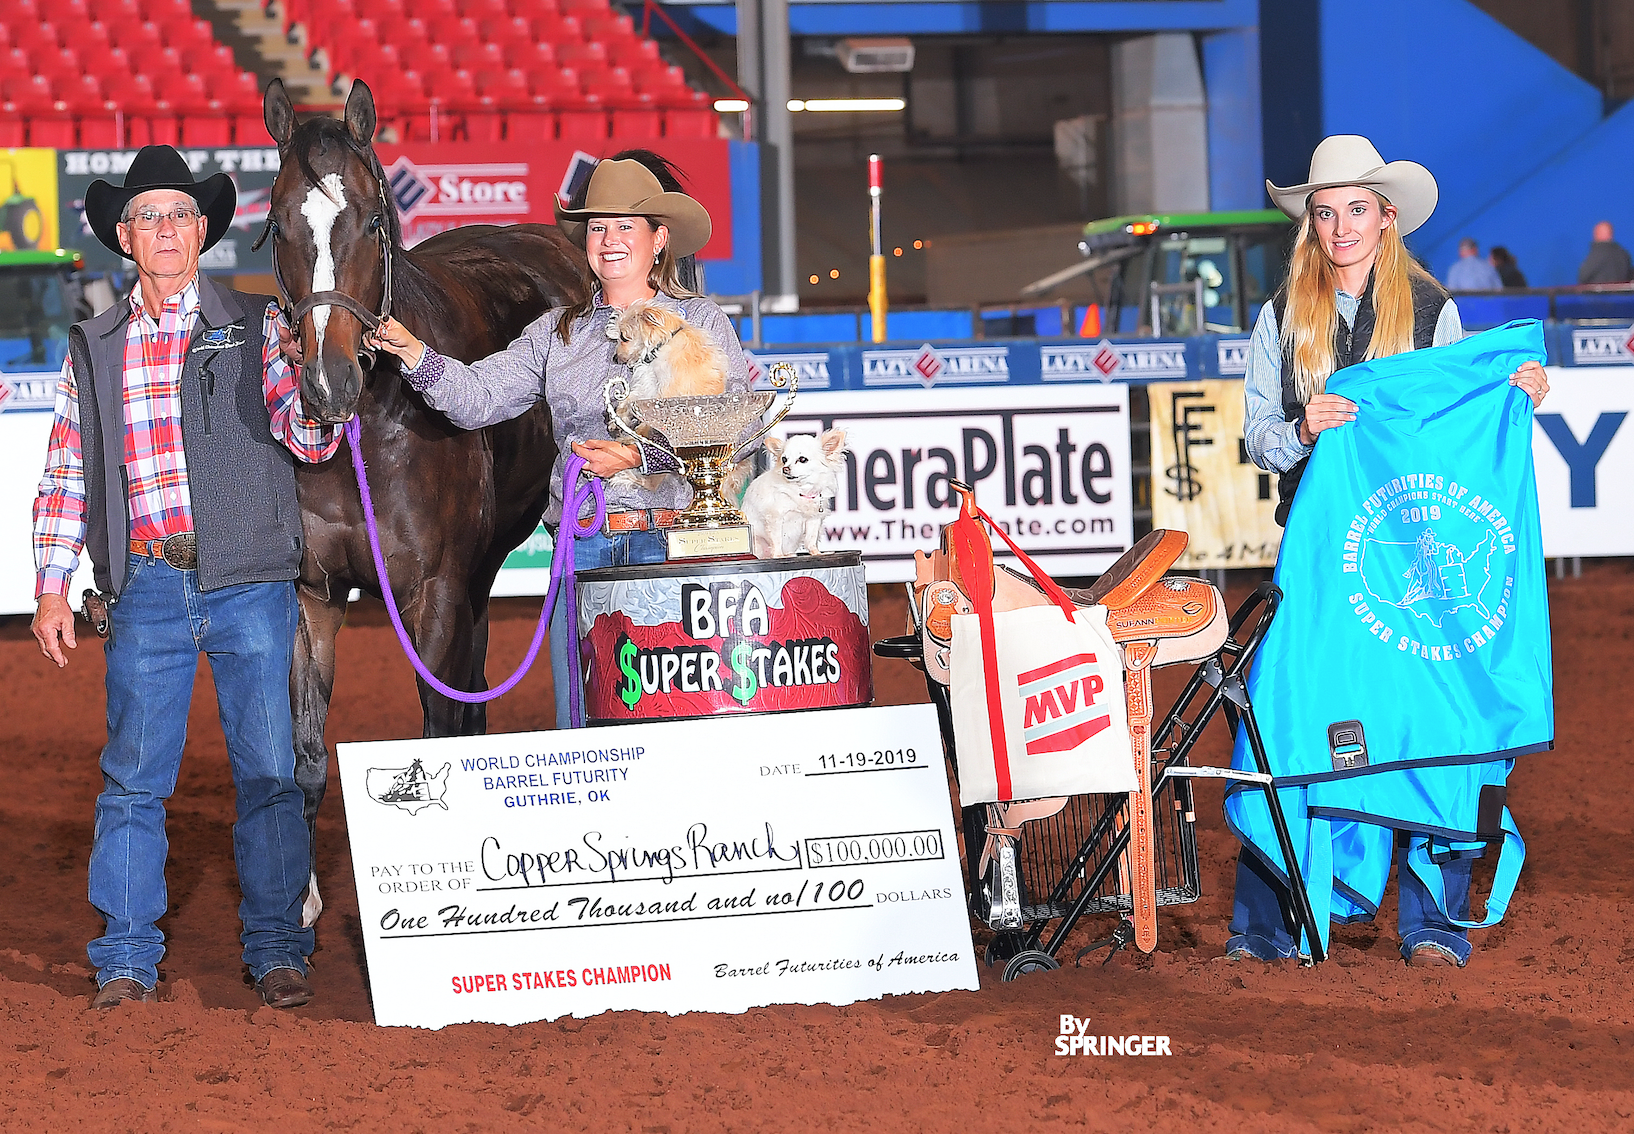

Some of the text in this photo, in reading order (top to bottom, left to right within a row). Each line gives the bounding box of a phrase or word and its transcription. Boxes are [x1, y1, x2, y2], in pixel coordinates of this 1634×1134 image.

[65, 151, 138, 175] HOM
[438, 173, 527, 204] Store
[864, 359, 909, 376] LAZY
[948, 355, 1009, 374] ARENA
[1042, 354, 1087, 371] LAZY
[1124, 351, 1186, 369] ARENA
[1387, 490, 1429, 511] CHAMPIONS
[1431, 491, 1458, 509] START
[1343, 473, 1516, 573] BARREL FUTURITIES OF AMERICA
[1400, 505, 1441, 523] 2019
[689, 585, 770, 640] BFA
[1349, 575, 1514, 661] SUPER STAKES CHAMPION
[1023, 674, 1104, 729] MVP
[460, 746, 646, 772] WORLD CHAMPIONSHIP
[759, 748, 917, 777] DATE 11-19-2019
[484, 767, 629, 791] BARREL FUTURITY
[503, 789, 610, 808] GUTHRIE, OK
[810, 833, 939, 865] $100,000.00
[371, 860, 475, 878] PAY TO THE
[378, 878, 471, 894] ORDER OF
[876, 887, 953, 904] DOLLARS
[379, 878, 865, 931] One Hundred Thousand and no/100
[713, 949, 961, 979] Barrel Futurities of America
[451, 962, 672, 995] SUPER STAKES CHAMPION
